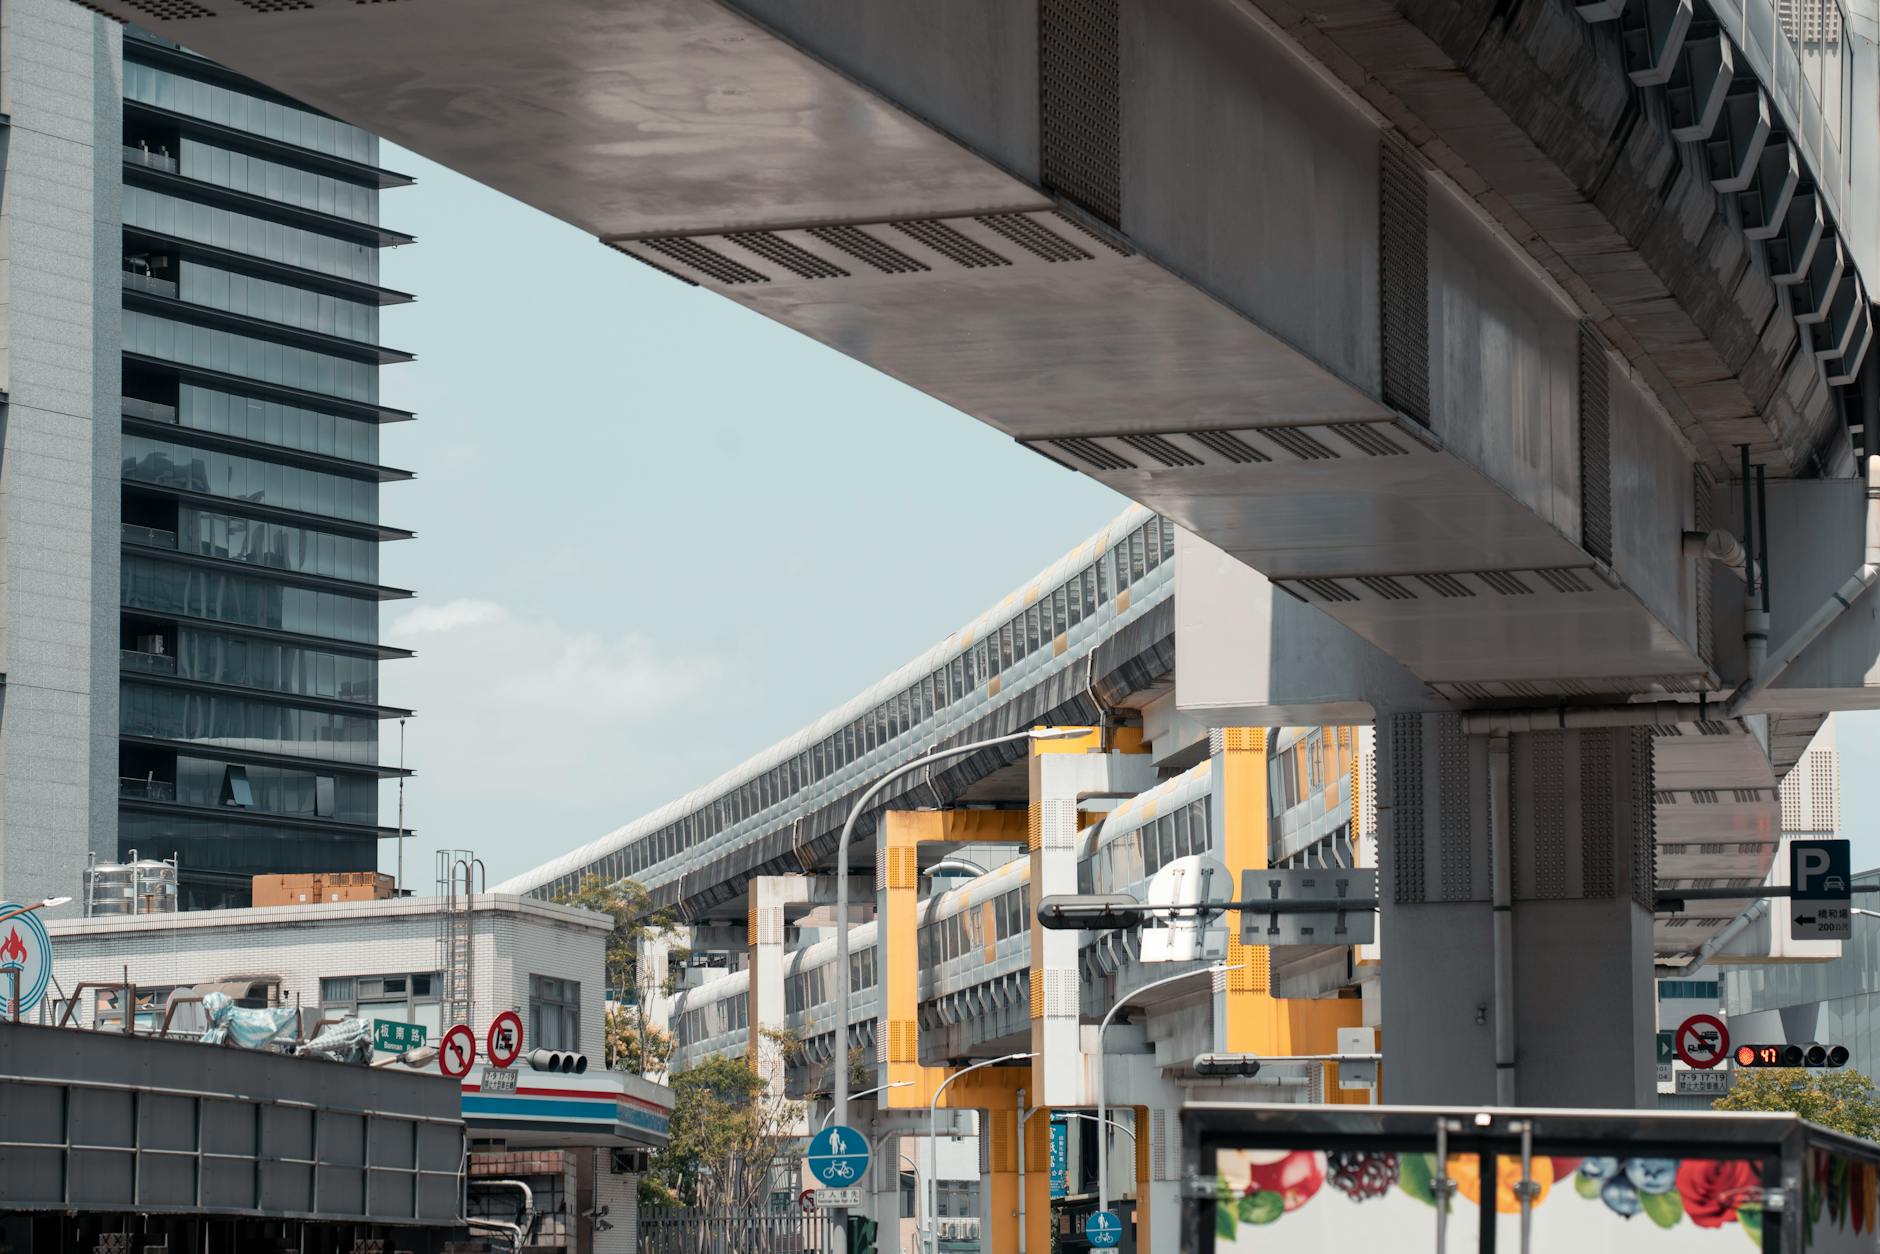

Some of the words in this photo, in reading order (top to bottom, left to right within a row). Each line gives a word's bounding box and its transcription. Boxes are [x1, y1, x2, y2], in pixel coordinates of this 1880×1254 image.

[1797, 848, 1830, 891] P
[380, 1023, 420, 1042] 板南路
[1760, 1048, 1776, 1063] 47
[1701, 1073, 1725, 1081] 17-19
[818, 1191, 857, 1199] 行人優先
